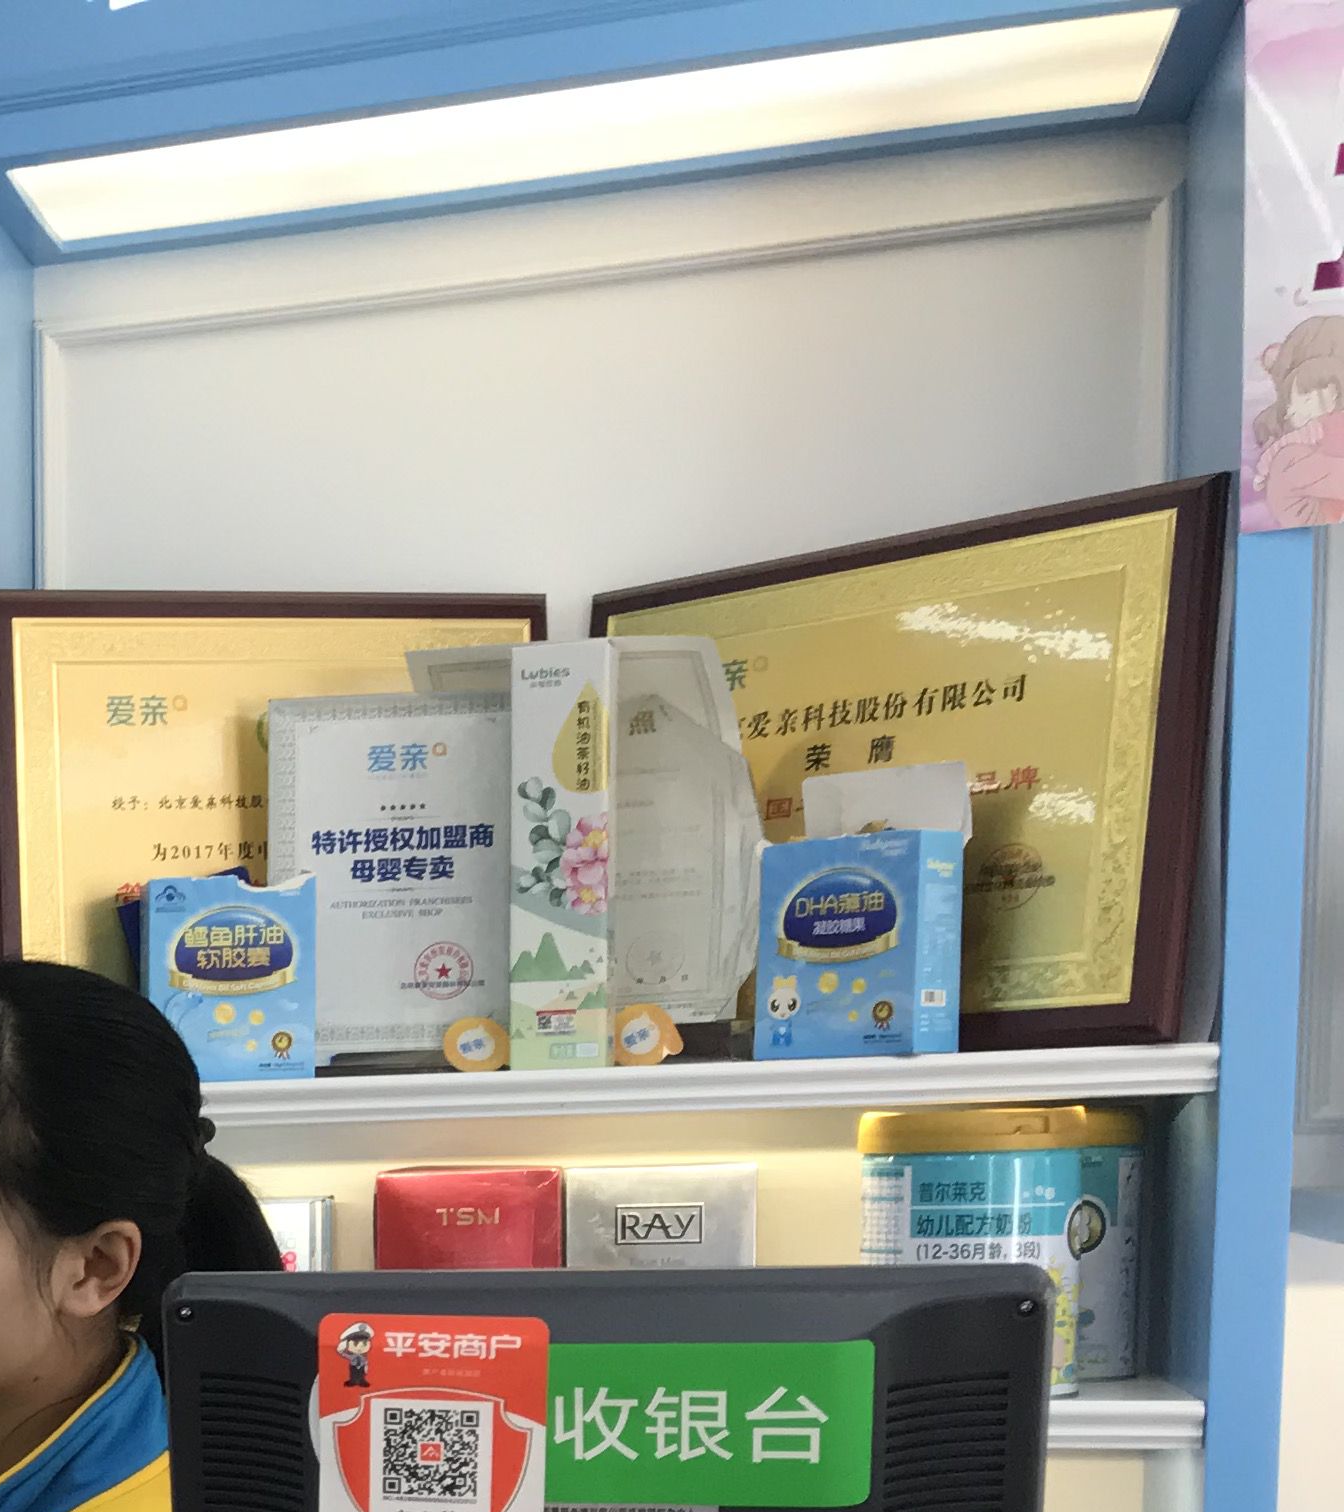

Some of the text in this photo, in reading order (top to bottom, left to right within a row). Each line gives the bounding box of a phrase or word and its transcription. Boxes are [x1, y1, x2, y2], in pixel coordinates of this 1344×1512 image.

[106, 694, 168, 728] 爱亲
[737, 673, 1027, 741] 爱亲科技股份有限公司
[367, 743, 429, 773] 爱亲
[312, 823, 495, 855] 特许授权加盟商
[350, 856, 455, 883] 母婴专卖
[184, 924, 285, 949] 鳕鱼肝油
[918, 1181, 987, 1203] 普尔莱克
[435, 1206, 500, 1227] TSM
[620, 1212, 696, 1242] RAY
[916, 1213, 1033, 1237] 幼儿配方奶粉
[383, 1330, 522, 1362] 平安商户
[553, 1385, 830, 1465] 收银台
